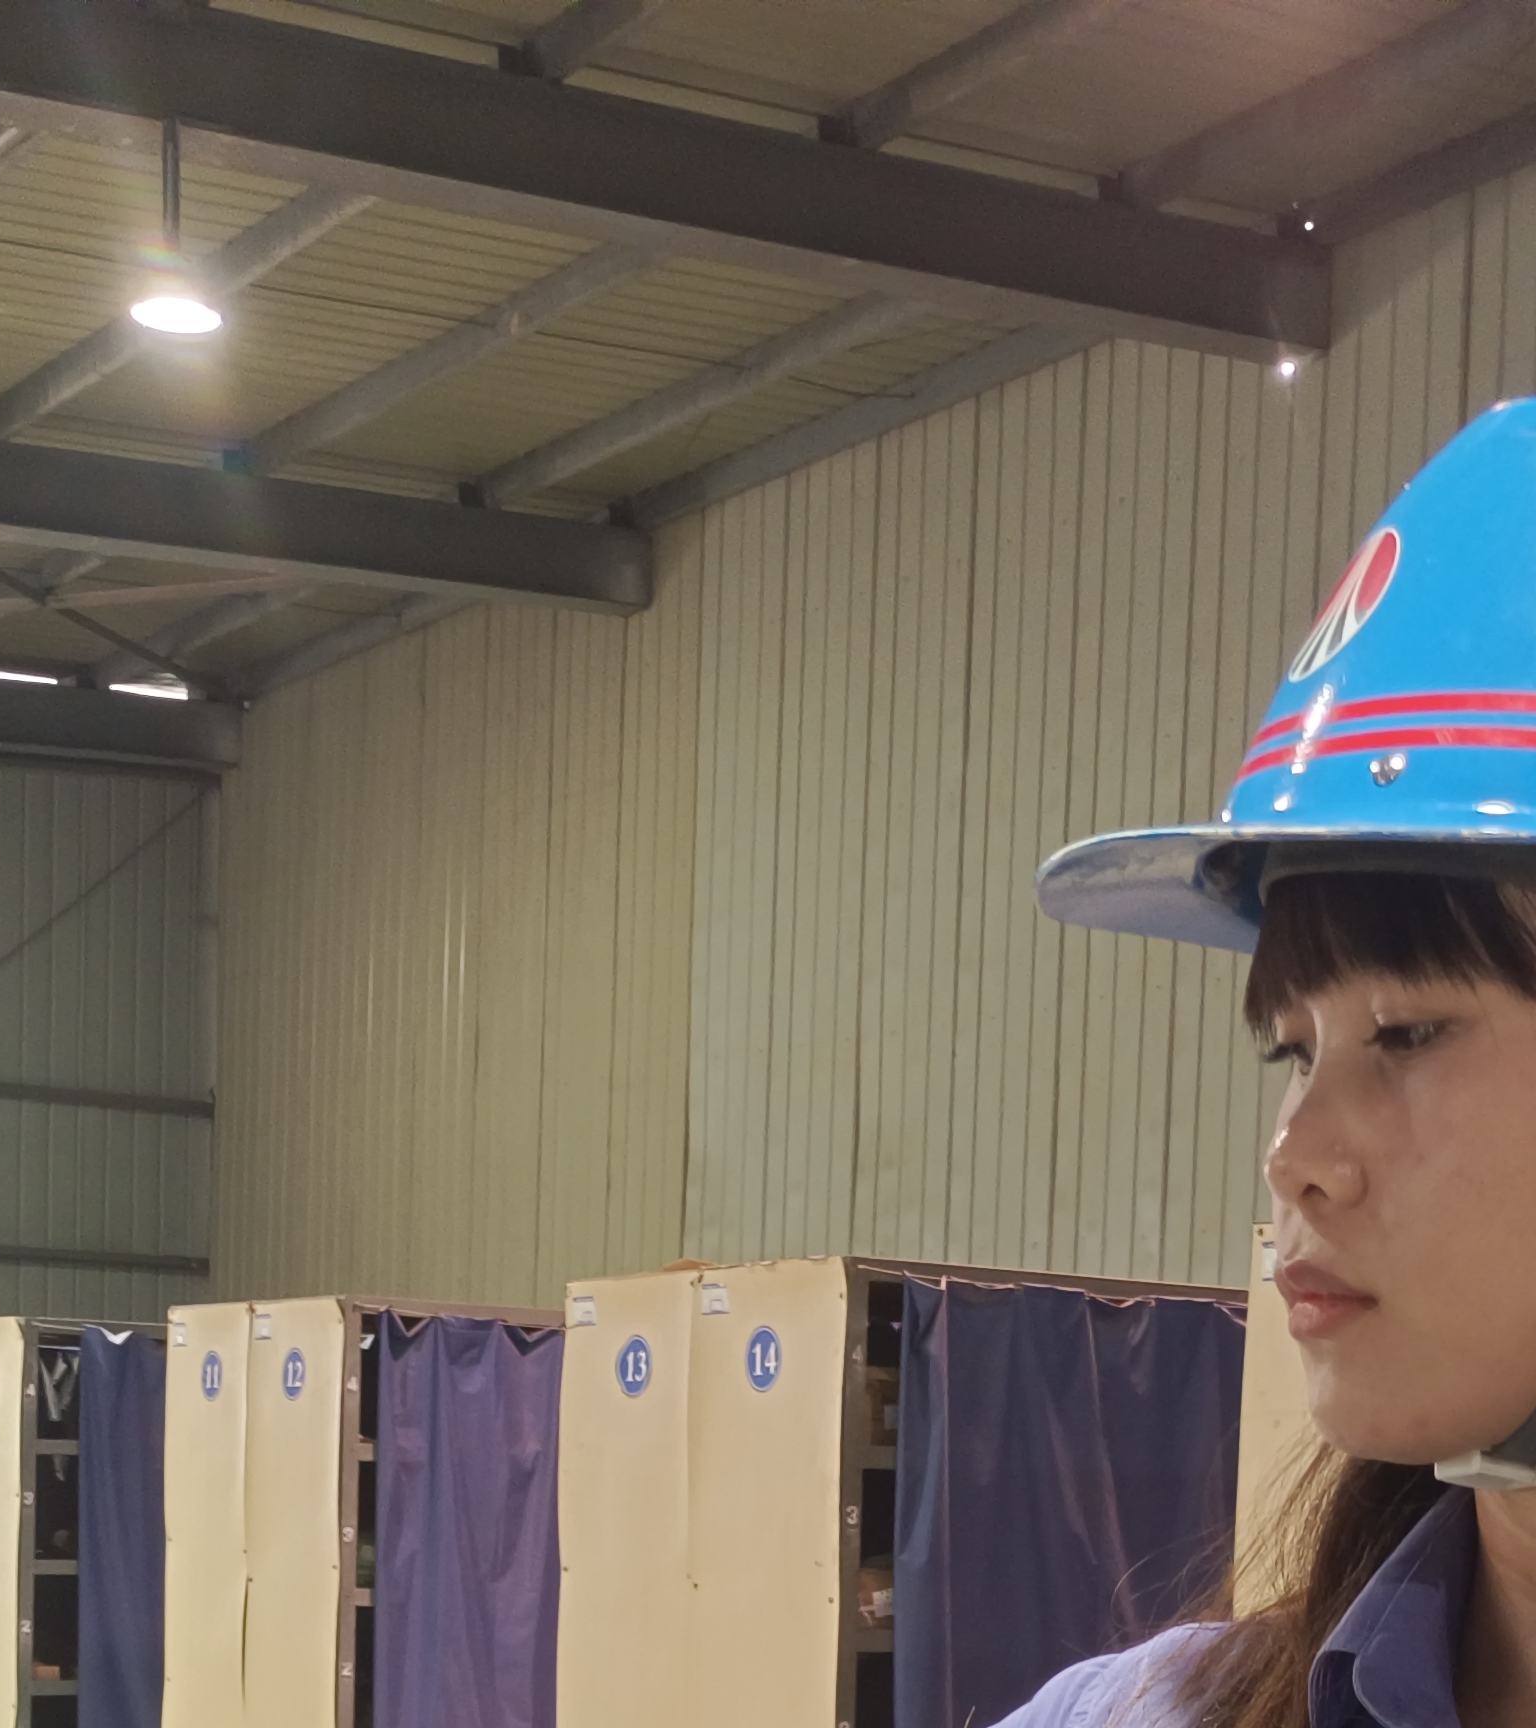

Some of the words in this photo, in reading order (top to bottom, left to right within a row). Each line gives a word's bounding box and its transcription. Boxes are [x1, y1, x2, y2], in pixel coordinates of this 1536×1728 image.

[625, 1350, 647, 1382] 13
[751, 1342, 778, 1376] 14
[205, 1364, 219, 1389] 11
[286, 1360, 303, 1388] 12
[845, 1505, 858, 1525] 3
